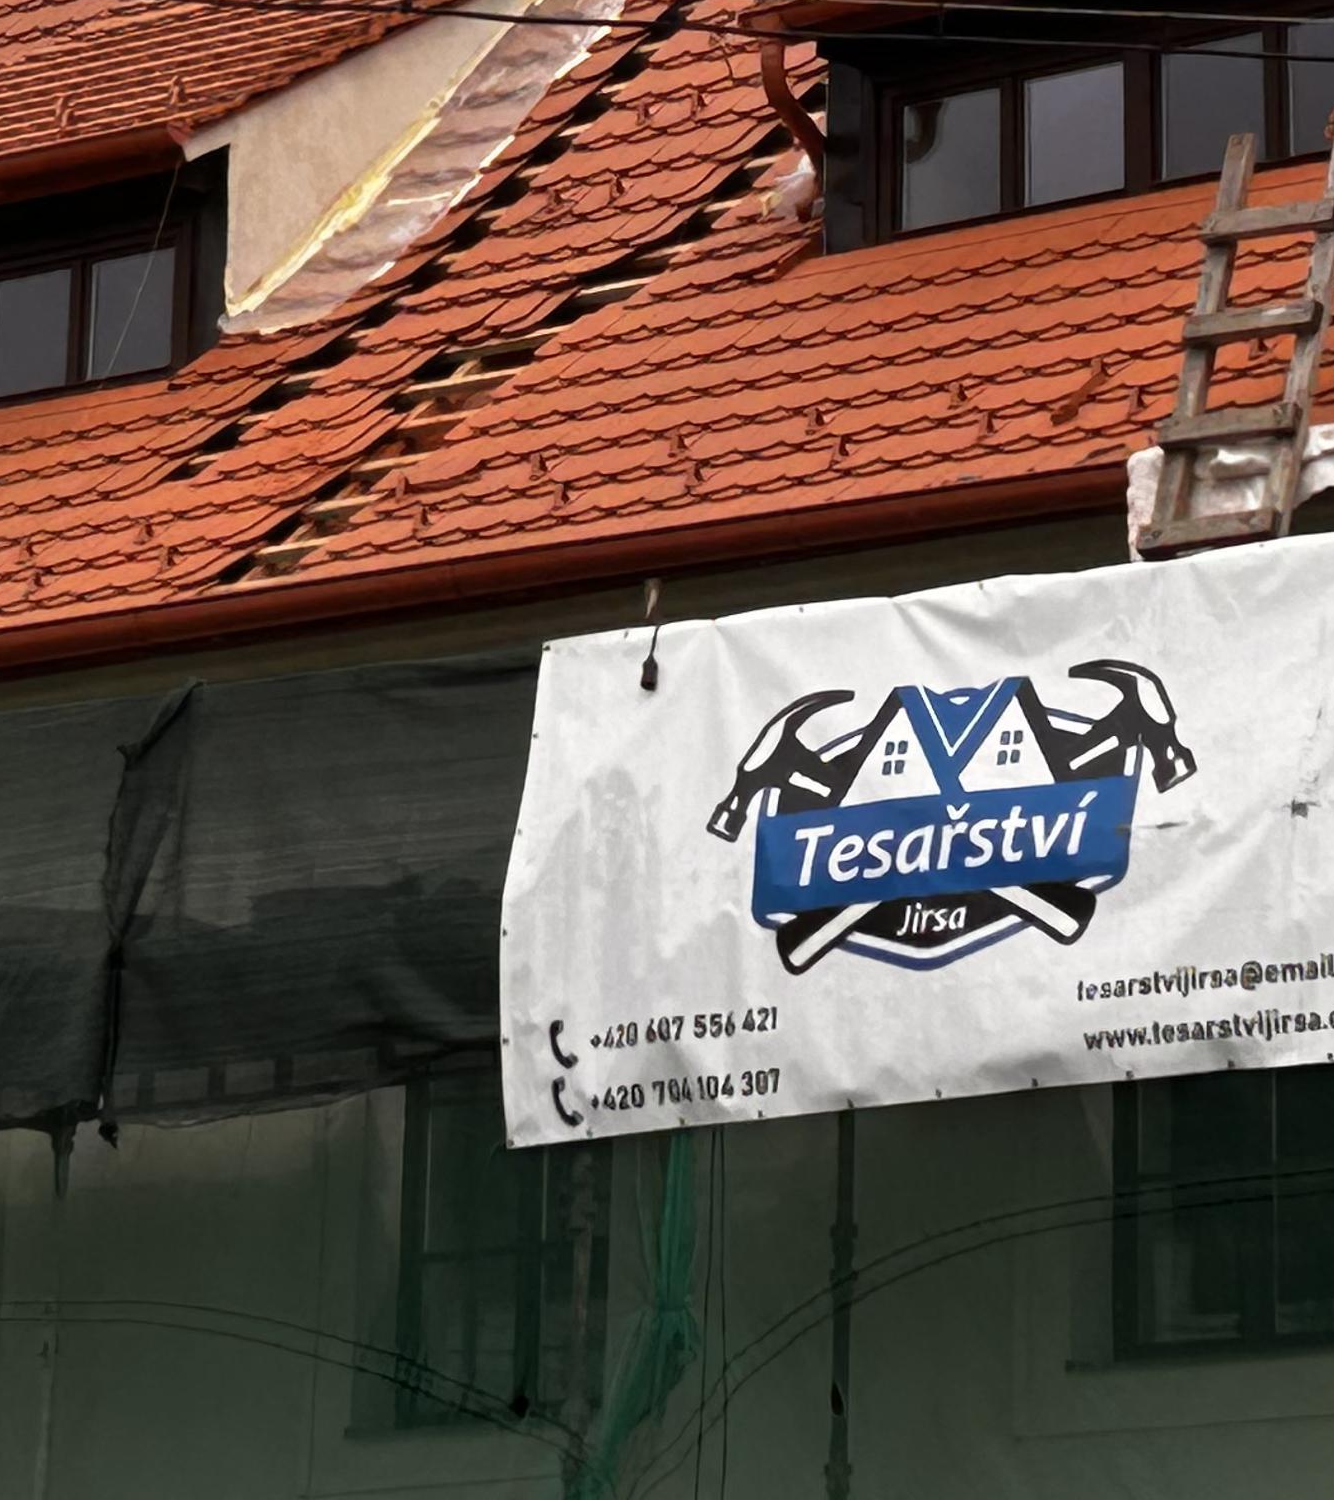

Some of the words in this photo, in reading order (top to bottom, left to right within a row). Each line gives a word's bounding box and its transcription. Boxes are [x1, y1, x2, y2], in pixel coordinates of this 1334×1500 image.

[794, 790, 1099, 887] Tesařství
[896, 902, 968, 937] Jirsa
[589, 1021, 639, 1049] +420
[645, 1015, 685, 1044] 607
[693, 1011, 736, 1039] 556
[741, 1006, 778, 1033] 421
[590, 1083, 645, 1111] +420
[652, 1076, 693, 1107] 704
[697, 1073, 735, 1101] 104
[741, 1067, 781, 1097] 307
